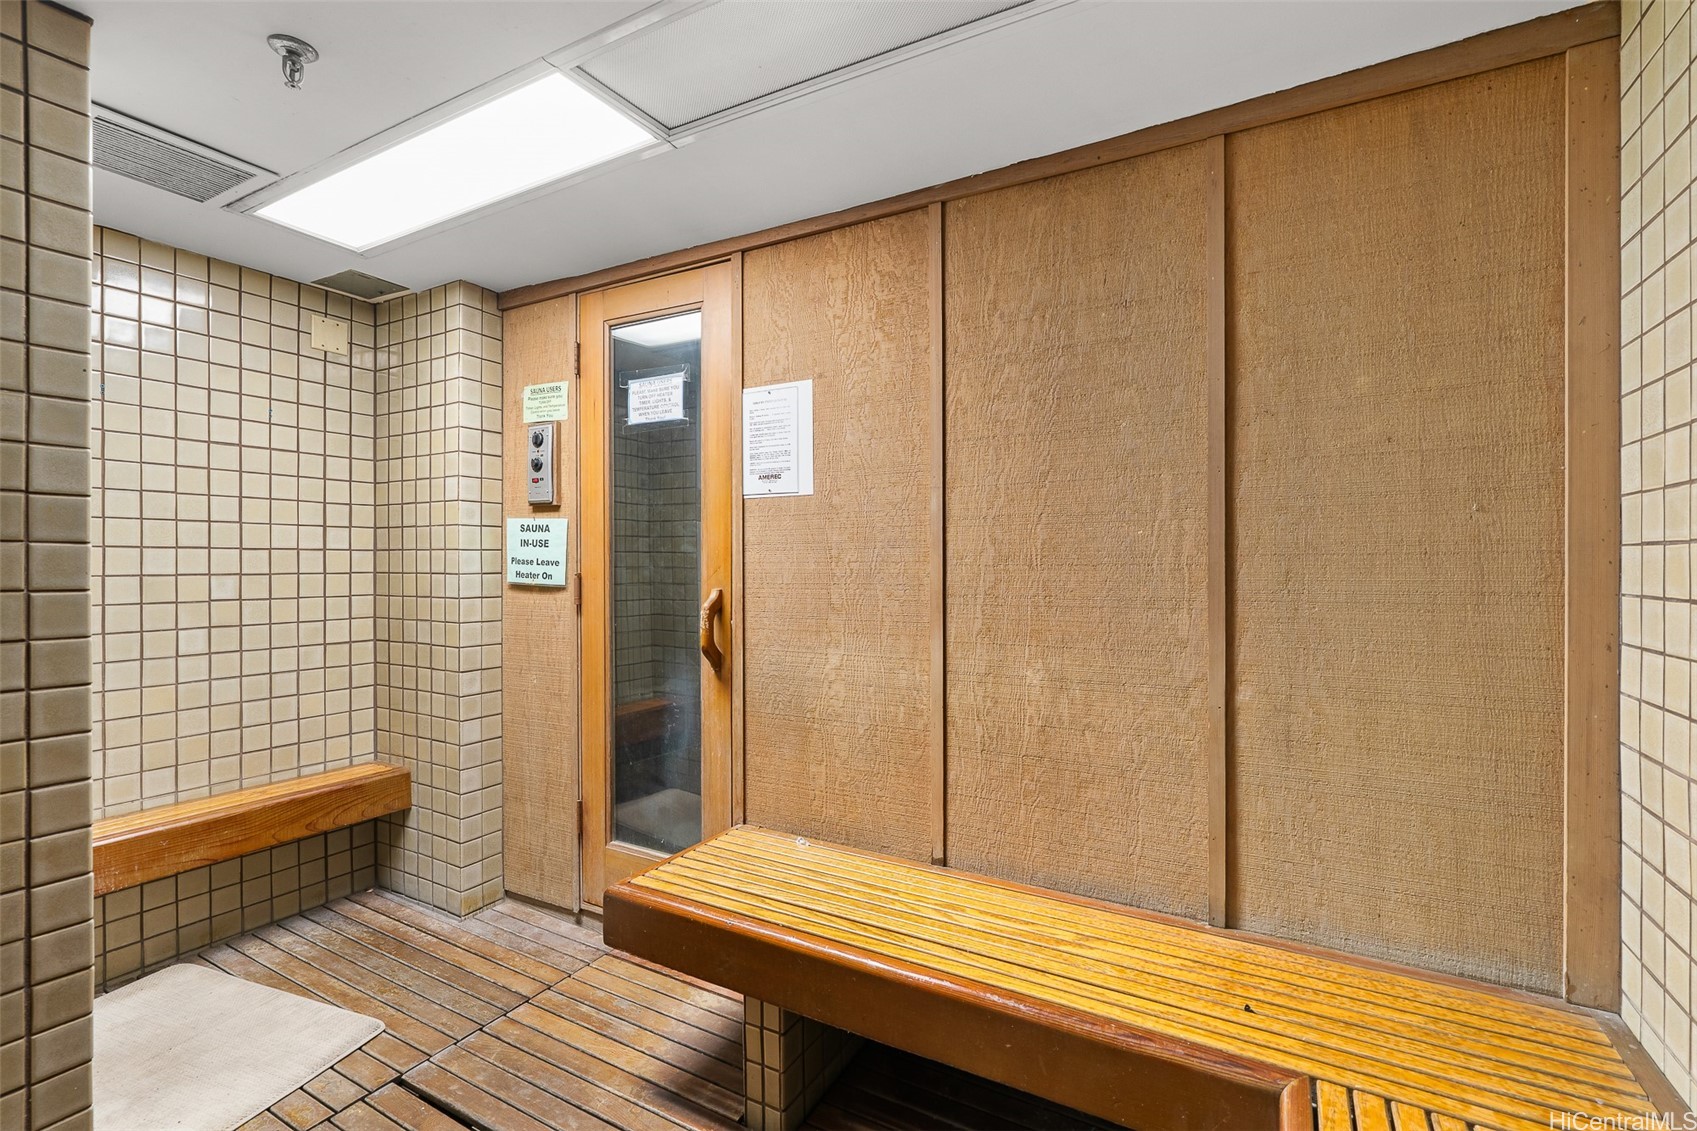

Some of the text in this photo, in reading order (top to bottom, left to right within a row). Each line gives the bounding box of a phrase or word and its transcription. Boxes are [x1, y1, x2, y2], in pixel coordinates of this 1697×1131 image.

[519, 523, 551, 533] SAUNA
[520, 539, 550, 548] IN-USE
[510, 556, 560, 567] Please Leave
[515, 570, 553, 580] Heater On
